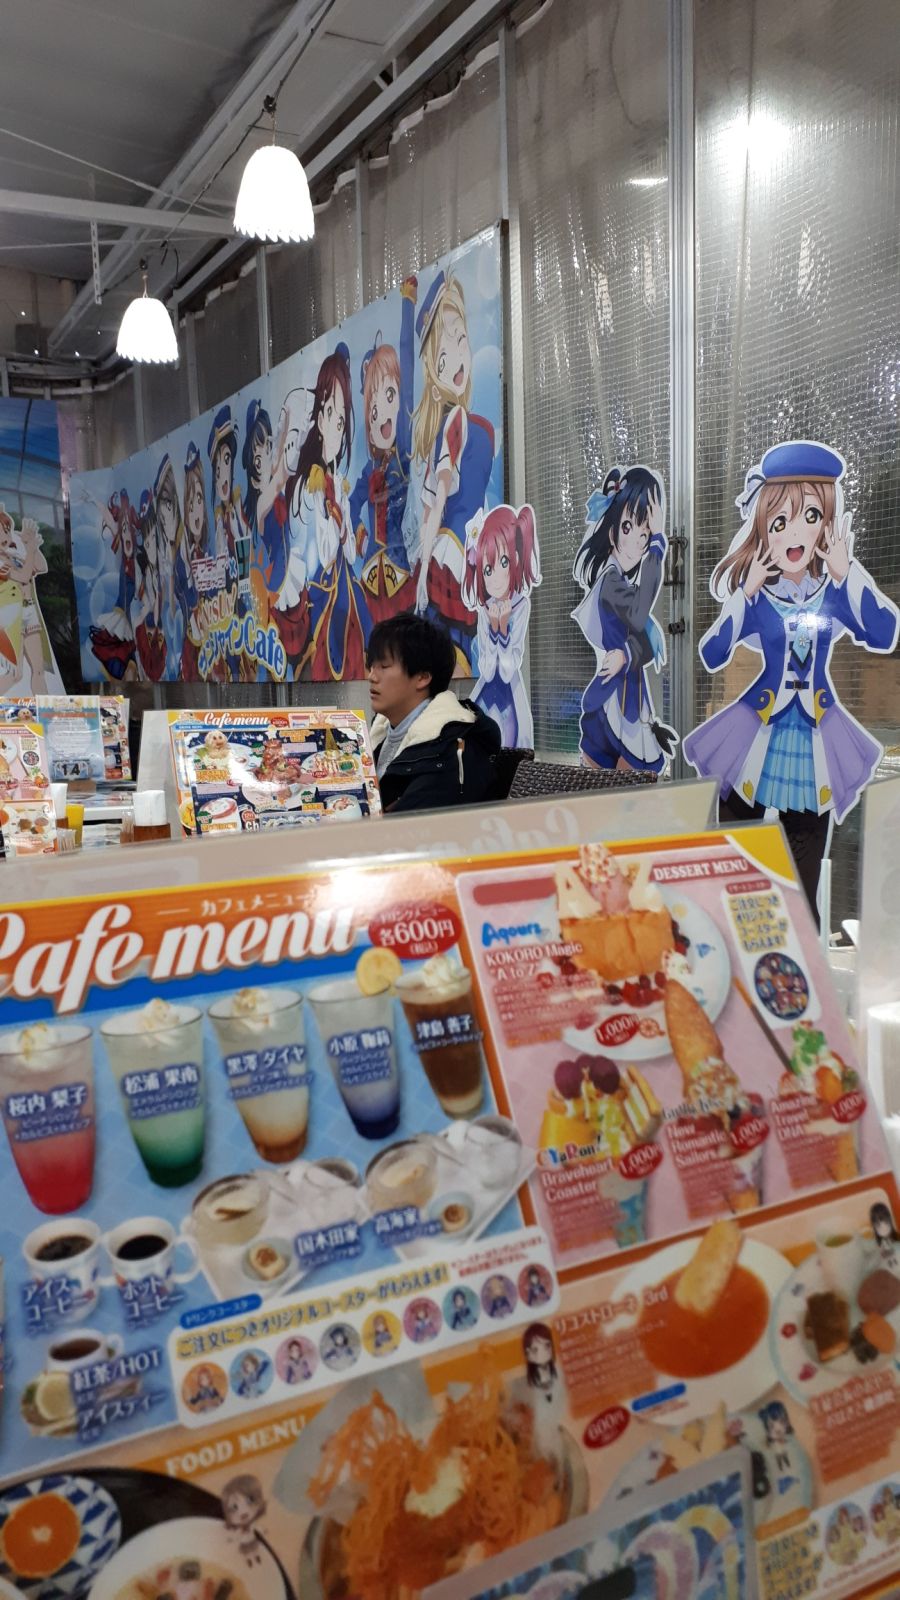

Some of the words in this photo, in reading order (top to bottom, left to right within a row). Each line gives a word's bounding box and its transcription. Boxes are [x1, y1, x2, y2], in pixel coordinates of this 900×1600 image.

[204, 712, 231, 729] Cafe
[231, 716, 268, 726] menu
[61, 763, 80, 776] 14
[653, 864, 711, 881] DESSERT
[713, 859, 749, 876] MENU
[152, 903, 356, 979] menu
[379, 918, 456, 947] 各600円
[481, 922, 542, 947] Aqours
[486, 948, 544, 967] KOKORO
[546, 941, 583, 958] Magic
[264, 1047, 304, 1068] ダイヤ
[164, 1066, 198, 1088] 果南
[9, 1094, 46, 1118] 桜内
[51, 1085, 86, 1109] 梨子
[546, 1181, 598, 1202] Coaster
[25, 1277, 70, 1303] アイス
[124, 1278, 162, 1301] ホット
[29, 1292, 95, 1322] コーヒー
[129, 1293, 185, 1318] コーヒー
[81, 1392, 167, 1428] アイスティー
[166, 1439, 233, 1478] FOOD
[238, 1414, 306, 1455] MENU
